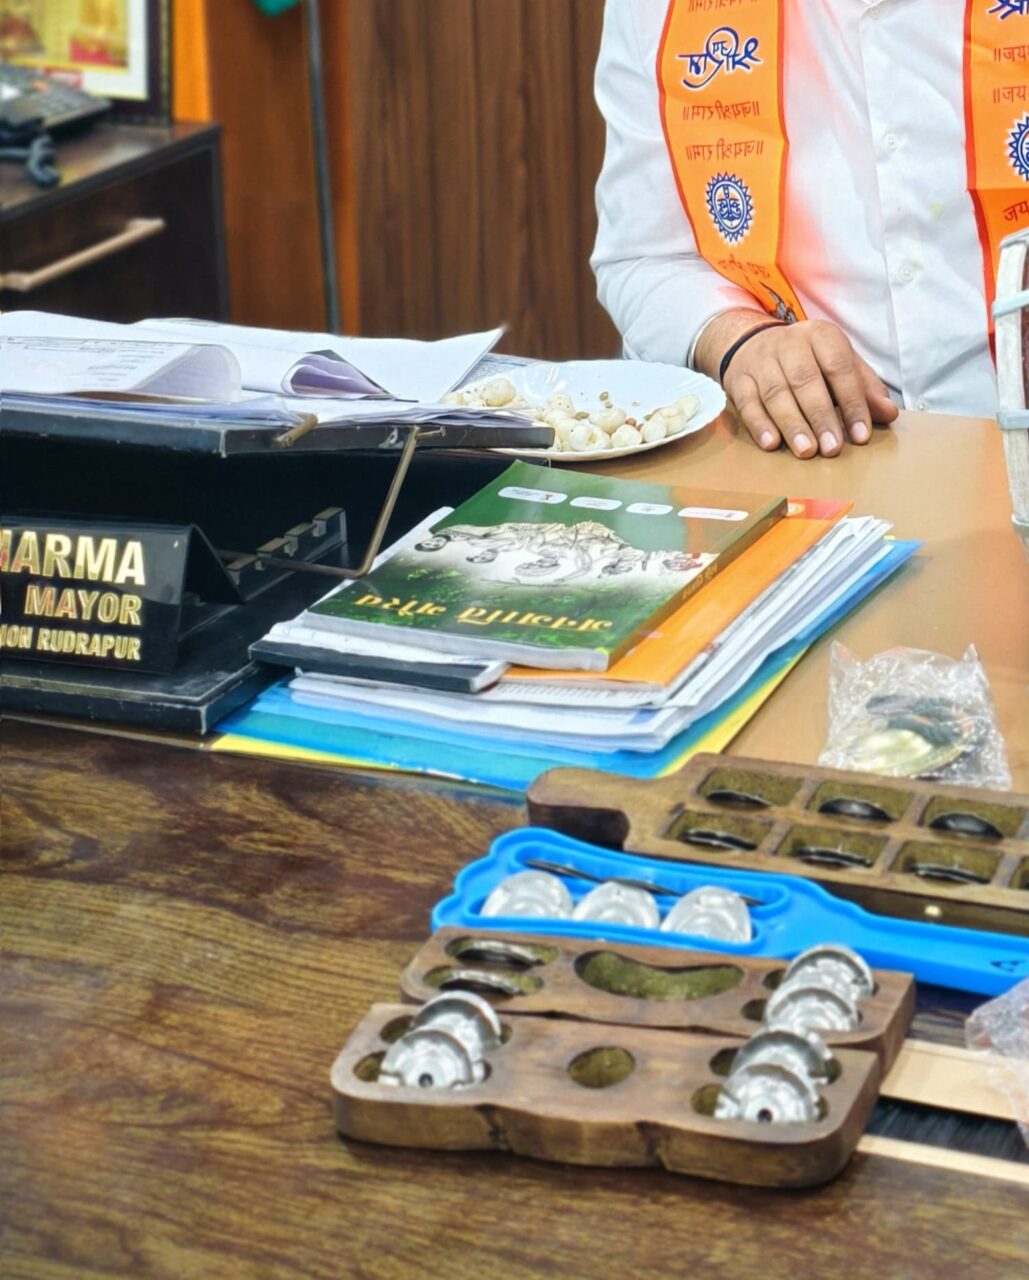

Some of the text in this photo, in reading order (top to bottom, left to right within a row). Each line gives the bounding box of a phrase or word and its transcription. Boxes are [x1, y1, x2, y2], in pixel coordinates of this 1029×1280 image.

[24, 584, 143, 626] MAYOR
[0, 623, 142, 661] ION RUDRAPUR
